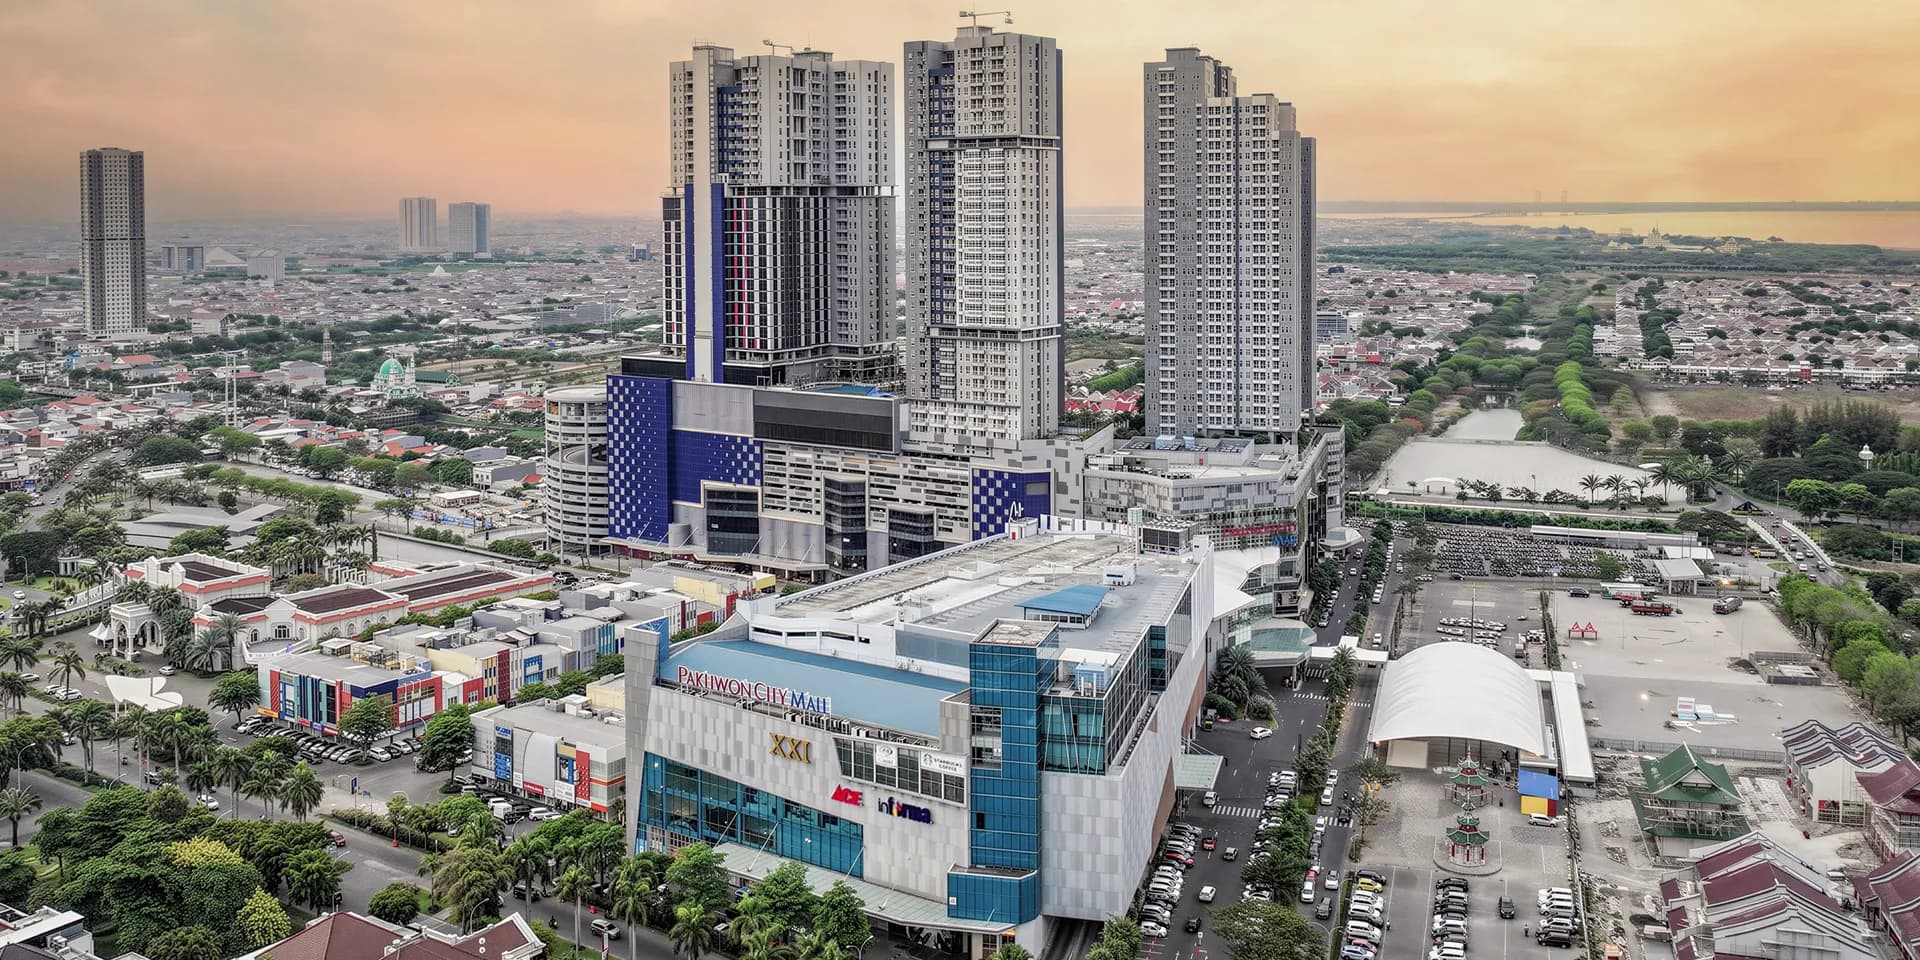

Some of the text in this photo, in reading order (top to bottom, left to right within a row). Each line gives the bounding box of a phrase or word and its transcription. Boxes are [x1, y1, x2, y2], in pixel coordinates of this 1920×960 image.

[678, 666, 829, 714] PAKUWON CITY MALL
[769, 732, 811, 764] XXI
[831, 784, 864, 808] ACE
[878, 797, 932, 824] informa
